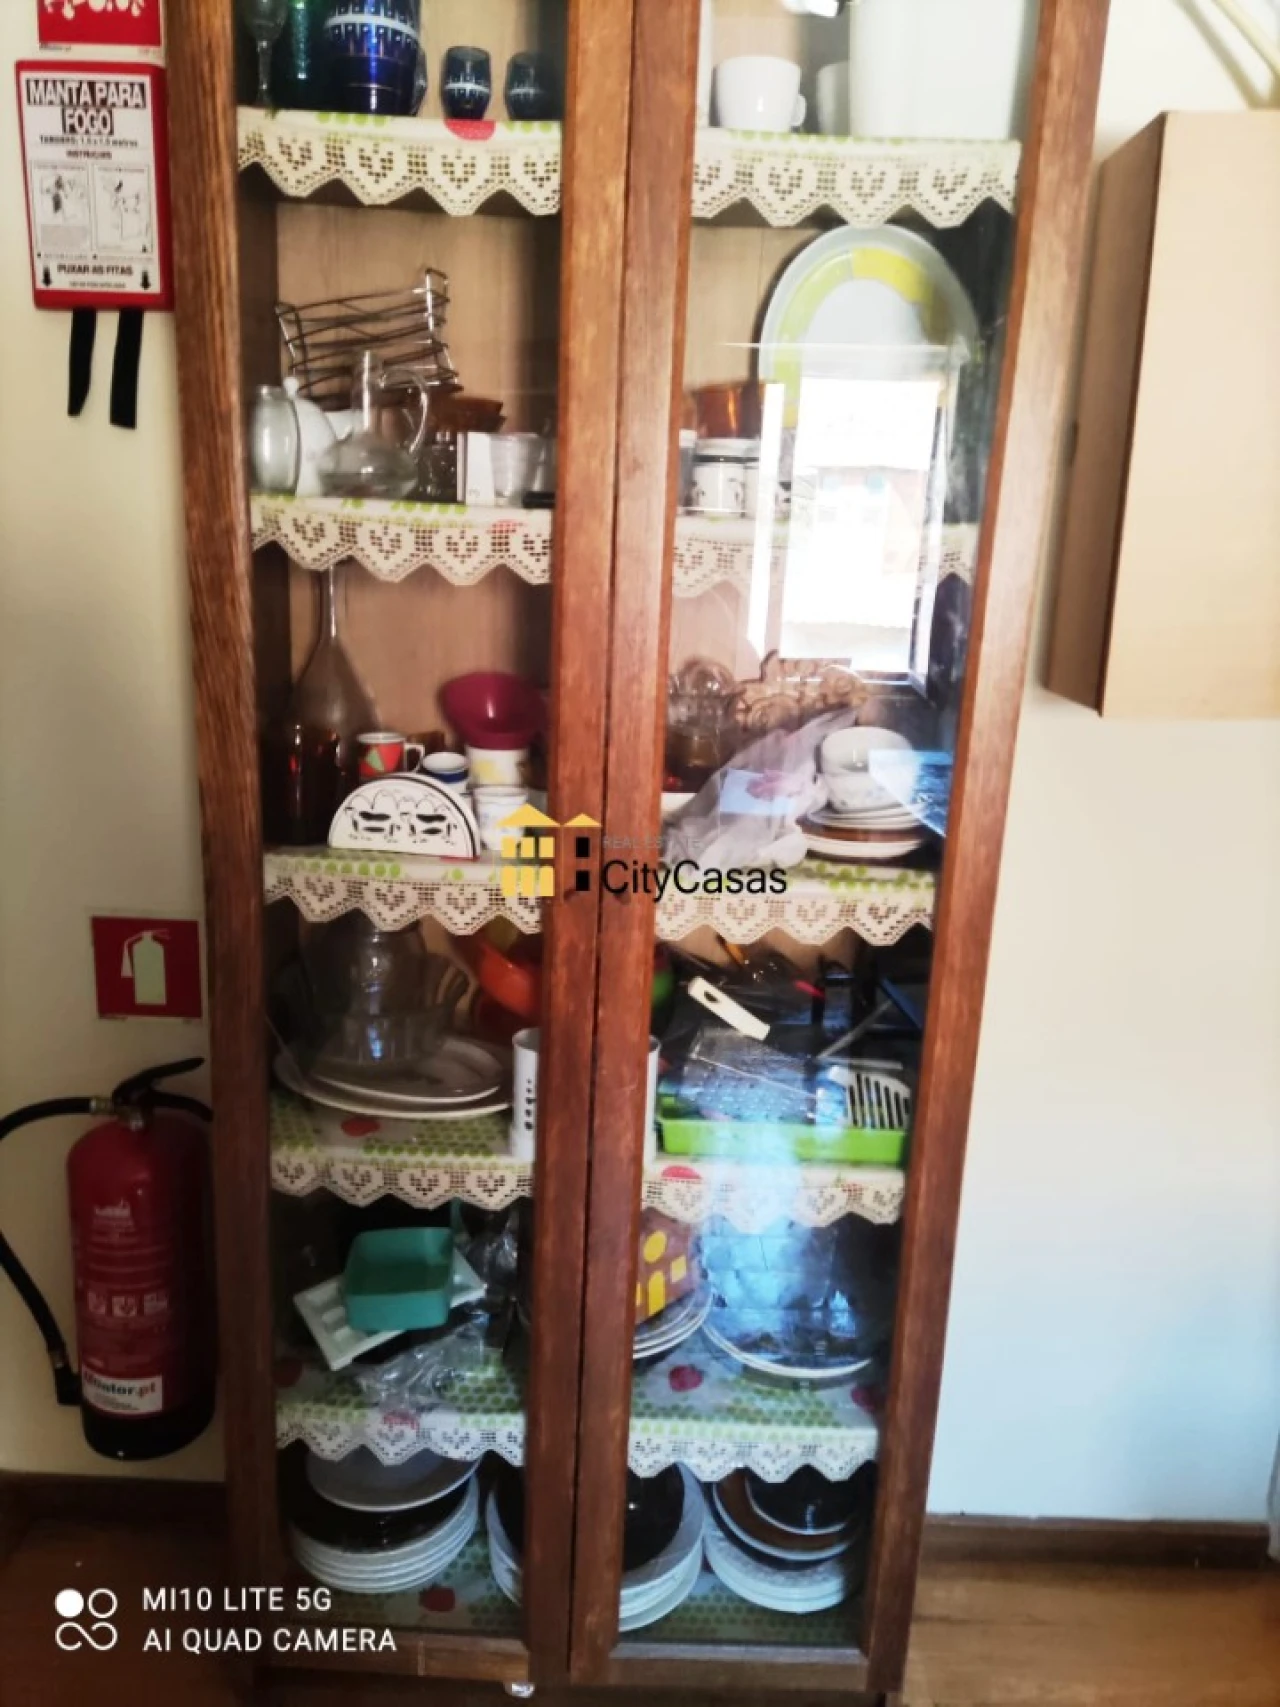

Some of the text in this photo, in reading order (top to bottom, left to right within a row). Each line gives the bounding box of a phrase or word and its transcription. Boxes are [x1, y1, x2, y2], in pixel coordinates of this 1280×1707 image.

[28, 79, 145, 108] MANTA PARA
[64, 108, 113, 135] FOGO
